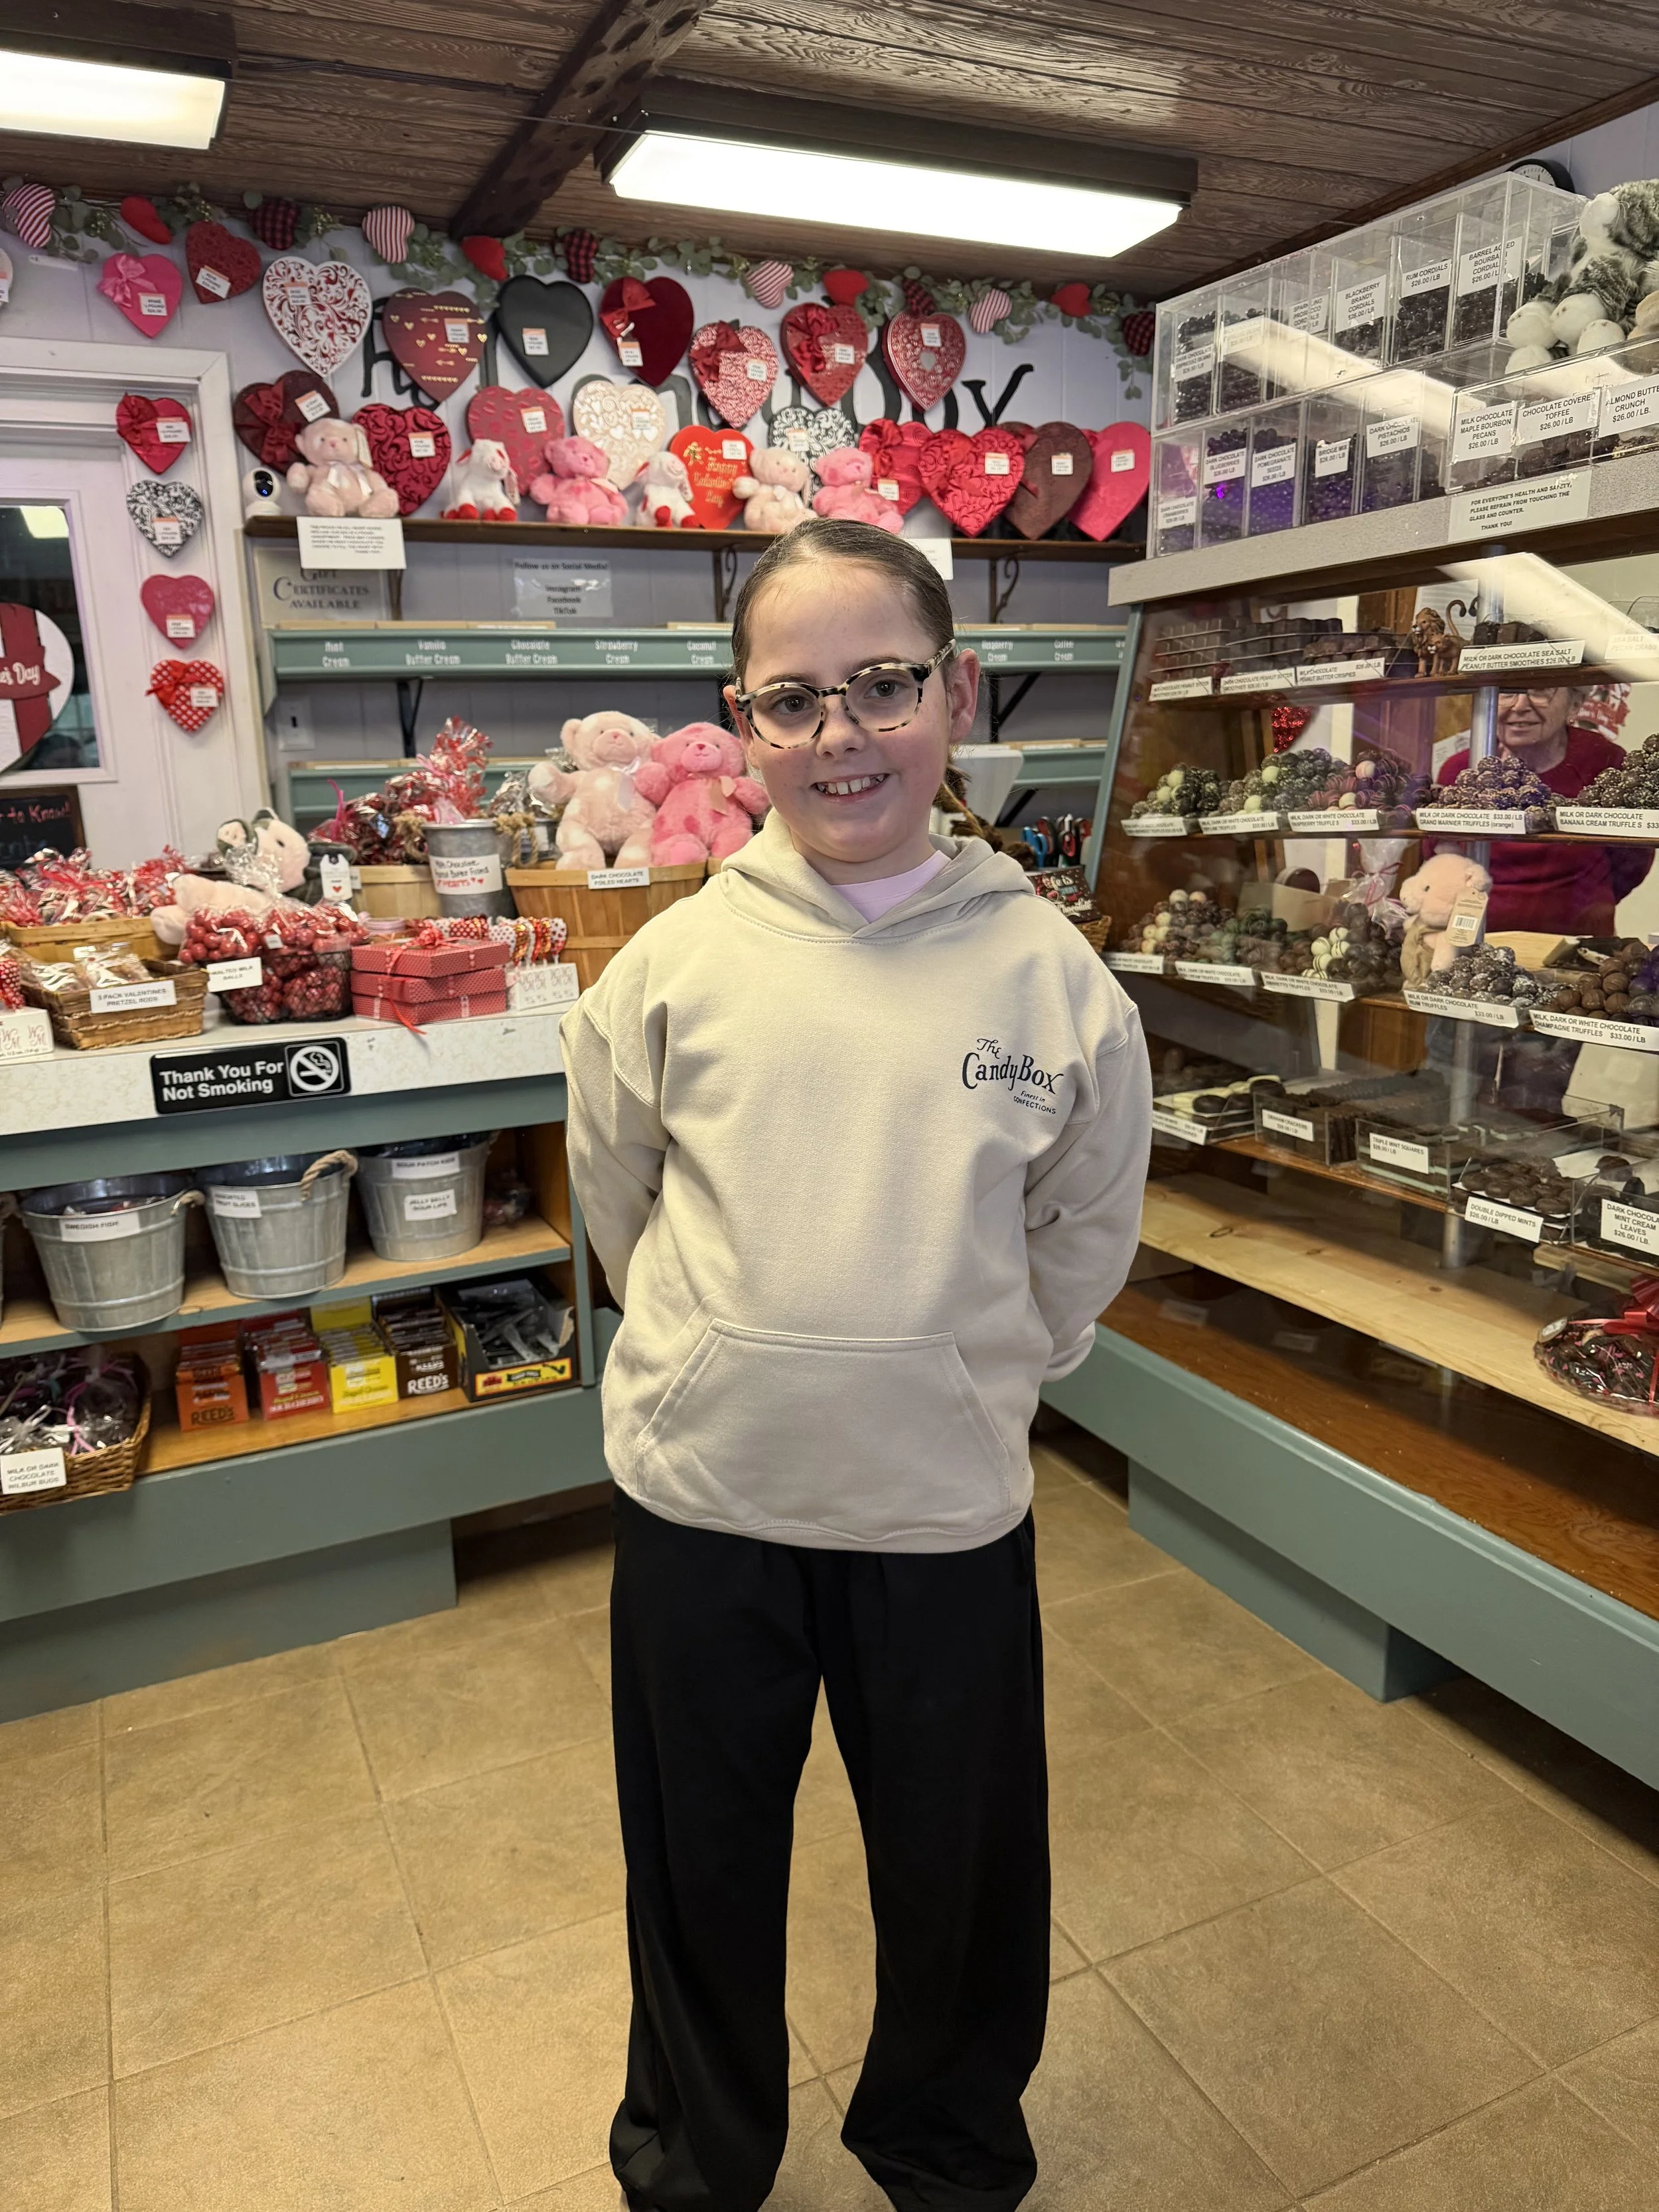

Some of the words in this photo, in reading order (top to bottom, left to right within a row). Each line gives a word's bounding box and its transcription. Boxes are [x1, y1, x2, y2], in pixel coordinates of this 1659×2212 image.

[1469, 249, 1492, 260] BARREL
[1419, 263, 1448, 276] CORDIALS
[1411, 277, 1429, 287] $26.00
[1472, 273, 1490, 283] $26.00
[1345, 282, 1380, 299] BLACKBERRY
[1351, 292, 1373, 304] BRANDY
[1348, 299, 1374, 313] CORDIALS
[1606, 392, 1635, 406] ALMOND
[1523, 402, 1561, 417] CHOCOLATE
[1615, 399, 1645, 412] CRUNCH
[1476, 409, 1513, 422] CHOCOLATE
[1546, 409, 1570, 420] TOFFEE
[1613, 411, 1634, 423] $26.00
[1369, 425, 1385, 434] DARK
[1461, 424, 1480, 433] MAPLE
[1481, 419, 1511, 429] BOURBON
[1540, 422, 1560, 431] $26.00
[1378, 427, 1410, 439] PISTACHIOS
[1473, 430, 1496, 439] PECANS
[1482, 493, 1514, 504] EVERYONE'S
[1529, 493, 1557, 503] TOUCHING
[1498, 508, 1524, 516] COUNTER.
[291, 600, 359, 609] AVAILABLE
[323, 656, 350, 668] Cream
[405, 653, 432, 666] Butter
[434, 654, 461, 665] Cream
[532, 654, 558, 665] Cream
[606, 654, 630, 664] Cream
[691, 654, 715, 665] Cream
[987, 652, 1008, 662] Cream
[1054, 652, 1073, 661] Cream
[1509, 658, 1544, 667] SMOOTHIES
[13, 662, 40, 686] Day
[123, 989, 166, 997] VALENTINES
[1422, 1001, 1447, 1011] TRUFFLES
[1445, 999, 1479, 1009] CHOCOLATE
[1536, 1021, 1570, 1032] CHAMPAGNE
[1571, 1027, 1603, 1037] TRUFFLES
[1578, 1019, 1598, 1028] WHITE
[1599, 1022, 1640, 1034] CHOCOLATE
[976, 1038, 1001, 1059] The
[159, 1067, 216, 1085] Thank
[218, 1064, 251, 1079] You
[254, 1061, 284, 1075] For
[162, 1085, 195, 1102] Not
[197, 1078, 273, 1098] Smoking
[1021, 1090, 1039, 1100] Finest
[1013, 1096, 1056, 1114] CONFECTIONS
[1607, 1203, 1625, 1214] DARK
[1471, 1204, 1494, 1215] DOUBLE
[1495, 1211, 1516, 1221] DIPPED
[1518, 1217, 1536, 1227] MINTS
[1615, 1214, 1630, 1223] MINT
[1632, 1219, 1656, 1230] CREAM
[1621, 1223, 1646, 1236] LEAVES
[9, 1470, 54, 1481] CHOCOLATE
